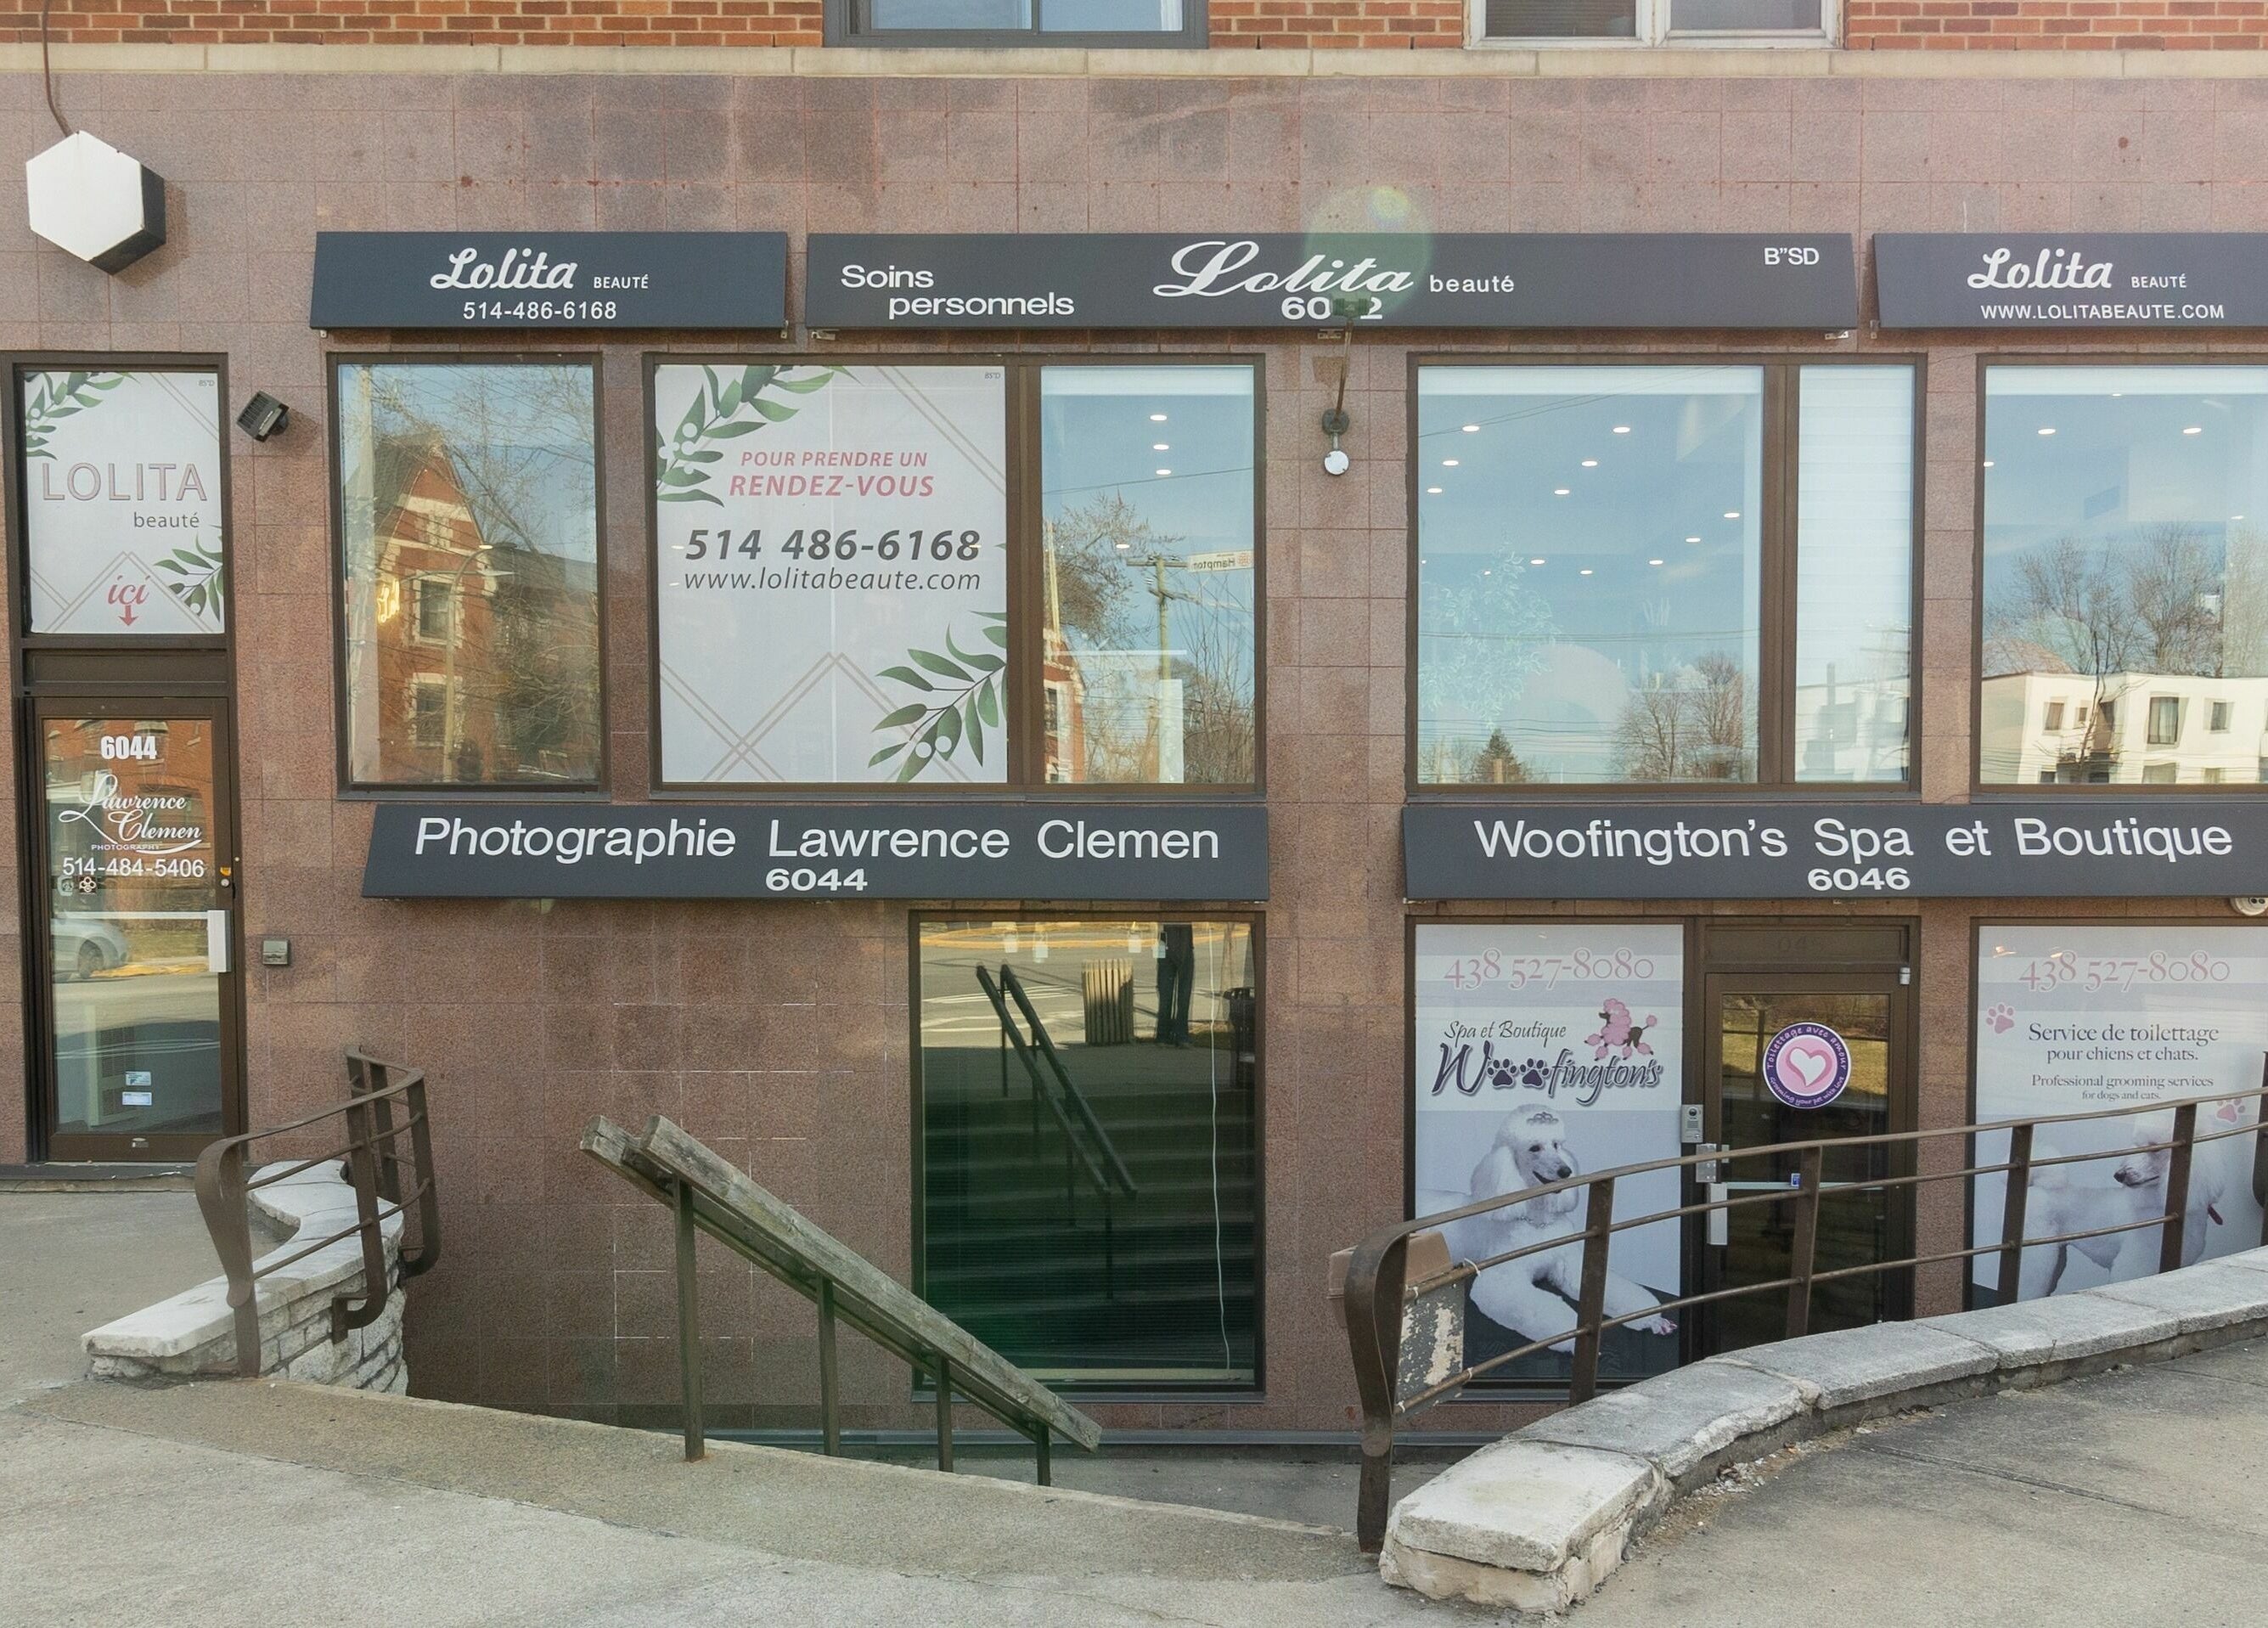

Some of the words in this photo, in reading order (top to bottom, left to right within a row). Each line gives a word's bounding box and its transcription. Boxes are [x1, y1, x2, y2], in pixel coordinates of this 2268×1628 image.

[430, 247, 578, 290] Lolita
[593, 273, 650, 290] BEAUTÉ
[841, 264, 934, 289] Soins
[1152, 240, 1414, 297] Lolita
[1429, 274, 1515, 293] beauté
[1967, 247, 2114, 290] Lolita
[2130, 273, 2187, 289] BEAUTÉ
[463, 301, 617, 320] 514-486-6168
[888, 291, 1075, 320] personnels
[1280, 296, 1383, 320] 602
[1980, 304, 2225, 319] WWW.LOLITABEAUTE.COM
[740, 451, 796, 467] POUR
[801, 451, 893, 467] PRENDRE
[899, 452, 928, 467] UN
[42, 462, 208, 501] LOLITA
[729, 475, 935, 498] RENDEZ-VOUS
[132, 511, 200, 528] beauté
[684, 529, 762, 561] 514
[780, 529, 981, 561] 486-6168
[684, 566, 981, 591] www.lolitabeaute.com
[100, 735, 158, 760] 6044
[58, 774, 188, 845] Lawrence
[108, 808, 202, 842] Clemen
[414, 817, 737, 865] Photographie
[768, 819, 1010, 859] Lawrence
[1037, 819, 1219, 859] Clemen
[1473, 819, 1788, 866] Woofington's
[1813, 818, 1914, 865] Spa
[1944, 820, 1992, 857] et
[2013, 817, 2233, 863] Boutique
[62, 856, 205, 878] 514-484-5406
[1807, 867, 1911, 892] 6046
[764, 868, 868, 892] 6044
[1444, 948, 1501, 990] 438
[1508, 948, 1655, 991] 527-8080
[2019, 949, 2078, 993] 438
[2084, 949, 2231, 993] 527-8080
[1444, 1021, 1477, 1046] Spa
[1480, 1022, 1494, 1038] et
[1499, 1021, 1567, 1047] Boutique
[1806, 1026, 1829, 1038] avec
[2029, 1022, 2097, 1042] Service
[2102, 1022, 2125, 1042] de
[2130, 1023, 2220, 1047] toilettage
[2047, 1050, 2083, 1064] pour
[2085, 1046, 2134, 1061] chiens
[2136, 1049, 2152, 1061] et
[2154, 1046, 2199, 1061] chats.
[2031, 1074, 2104, 1088] Professional
[2106, 1075, 2165, 1090] grooming
[2167, 1075, 2215, 1088] services
[2082, 1090, 2096, 1100] for
[2096, 1090, 2120, 1102] dogs
[2121, 1090, 2139, 1100] and
